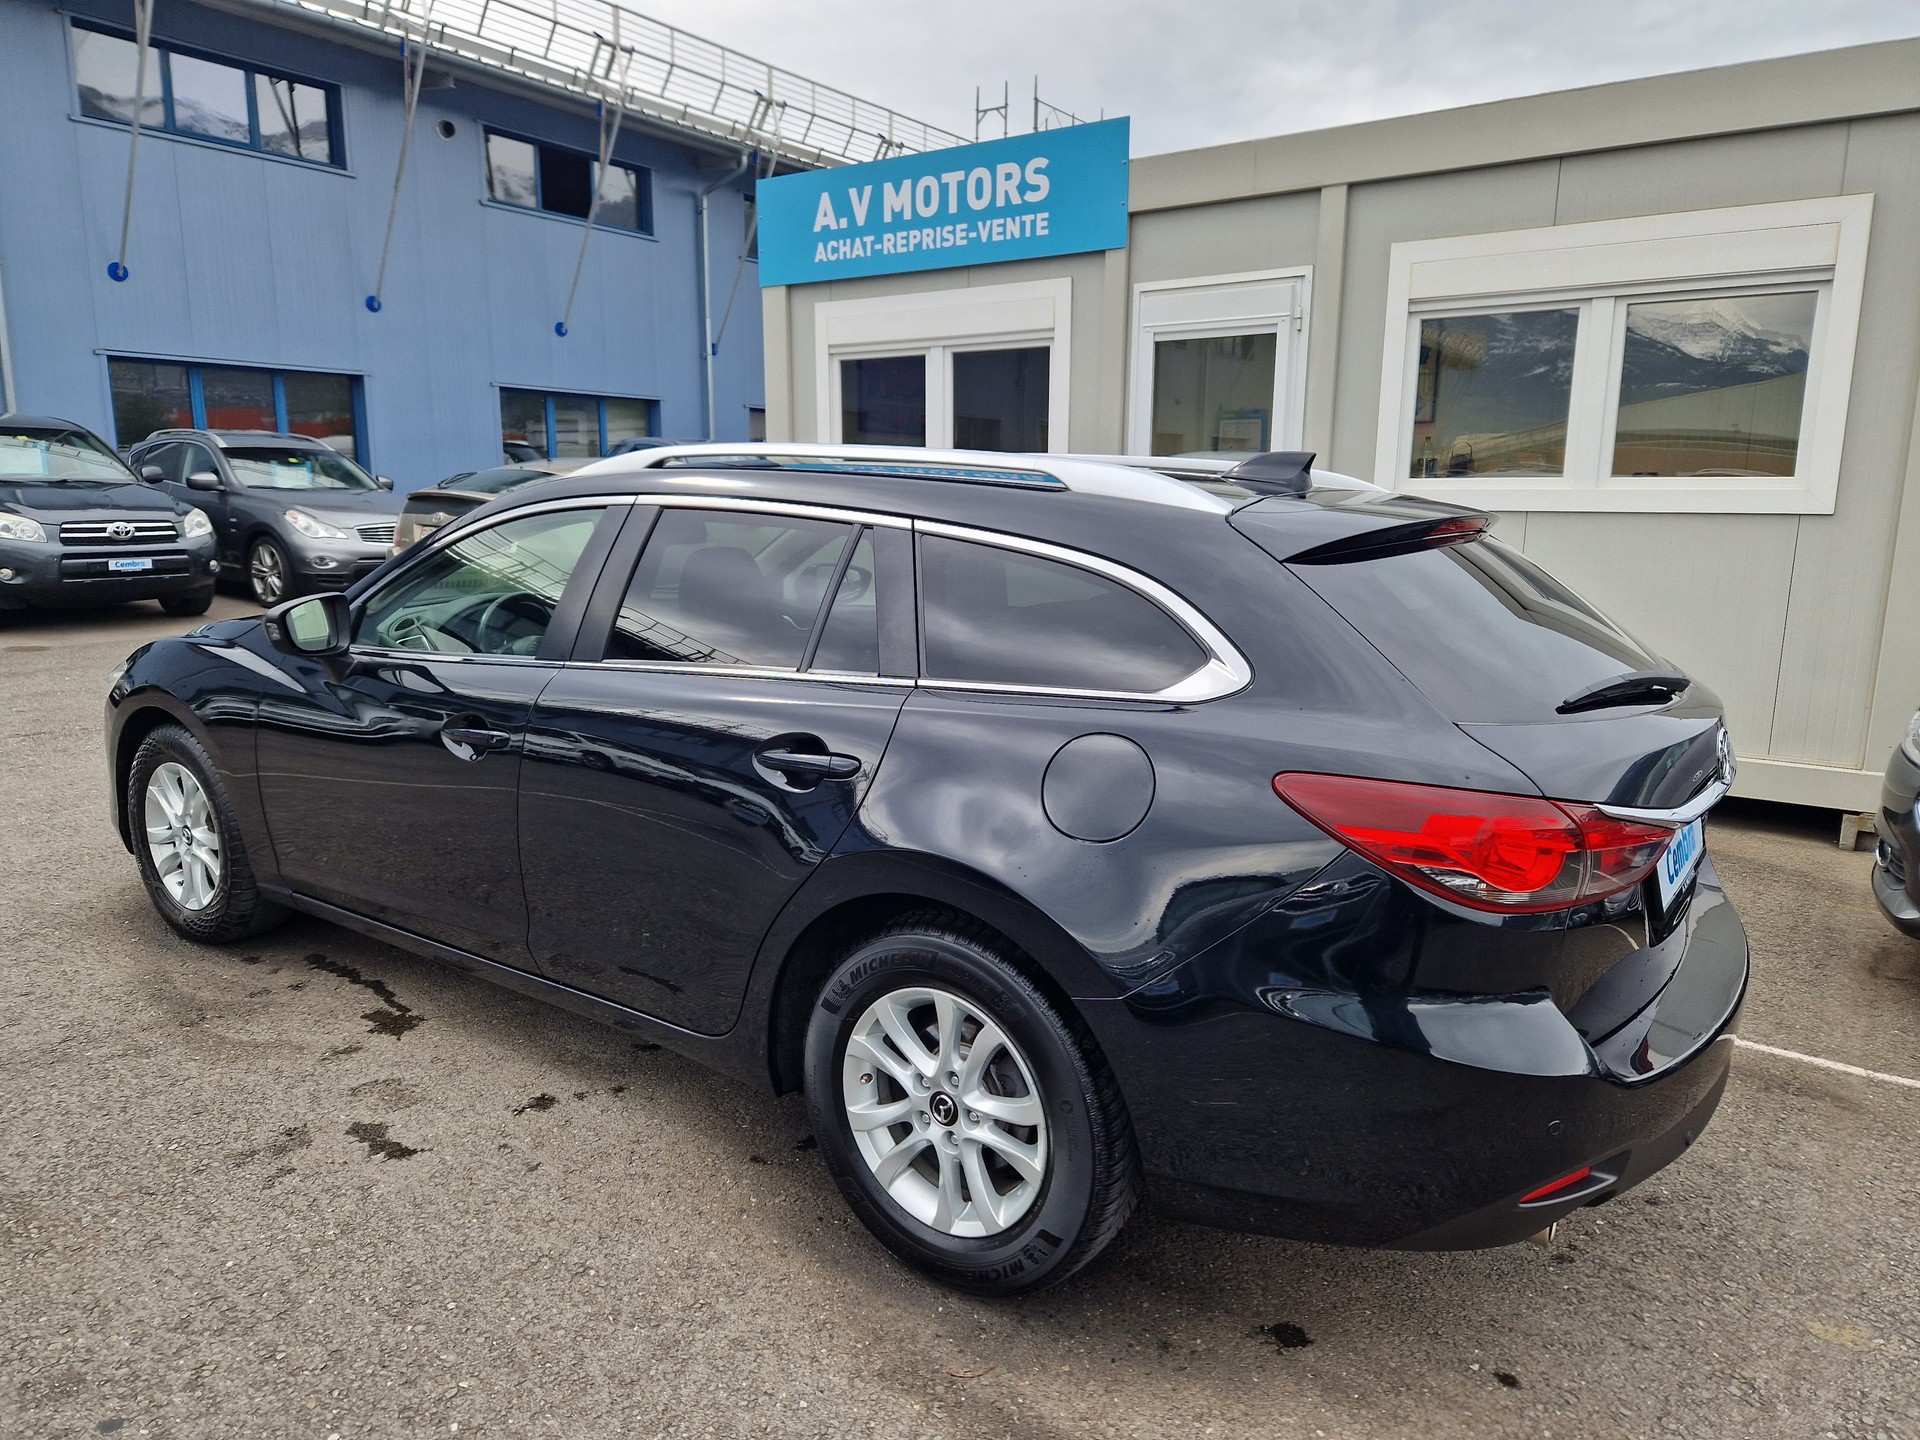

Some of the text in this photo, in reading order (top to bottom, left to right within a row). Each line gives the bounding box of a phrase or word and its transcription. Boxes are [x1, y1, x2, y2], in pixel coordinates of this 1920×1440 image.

[813, 157, 1050, 233] A.V MOTORS
[814, 212, 1050, 263] ACHAT-REPRISE-VENTE
